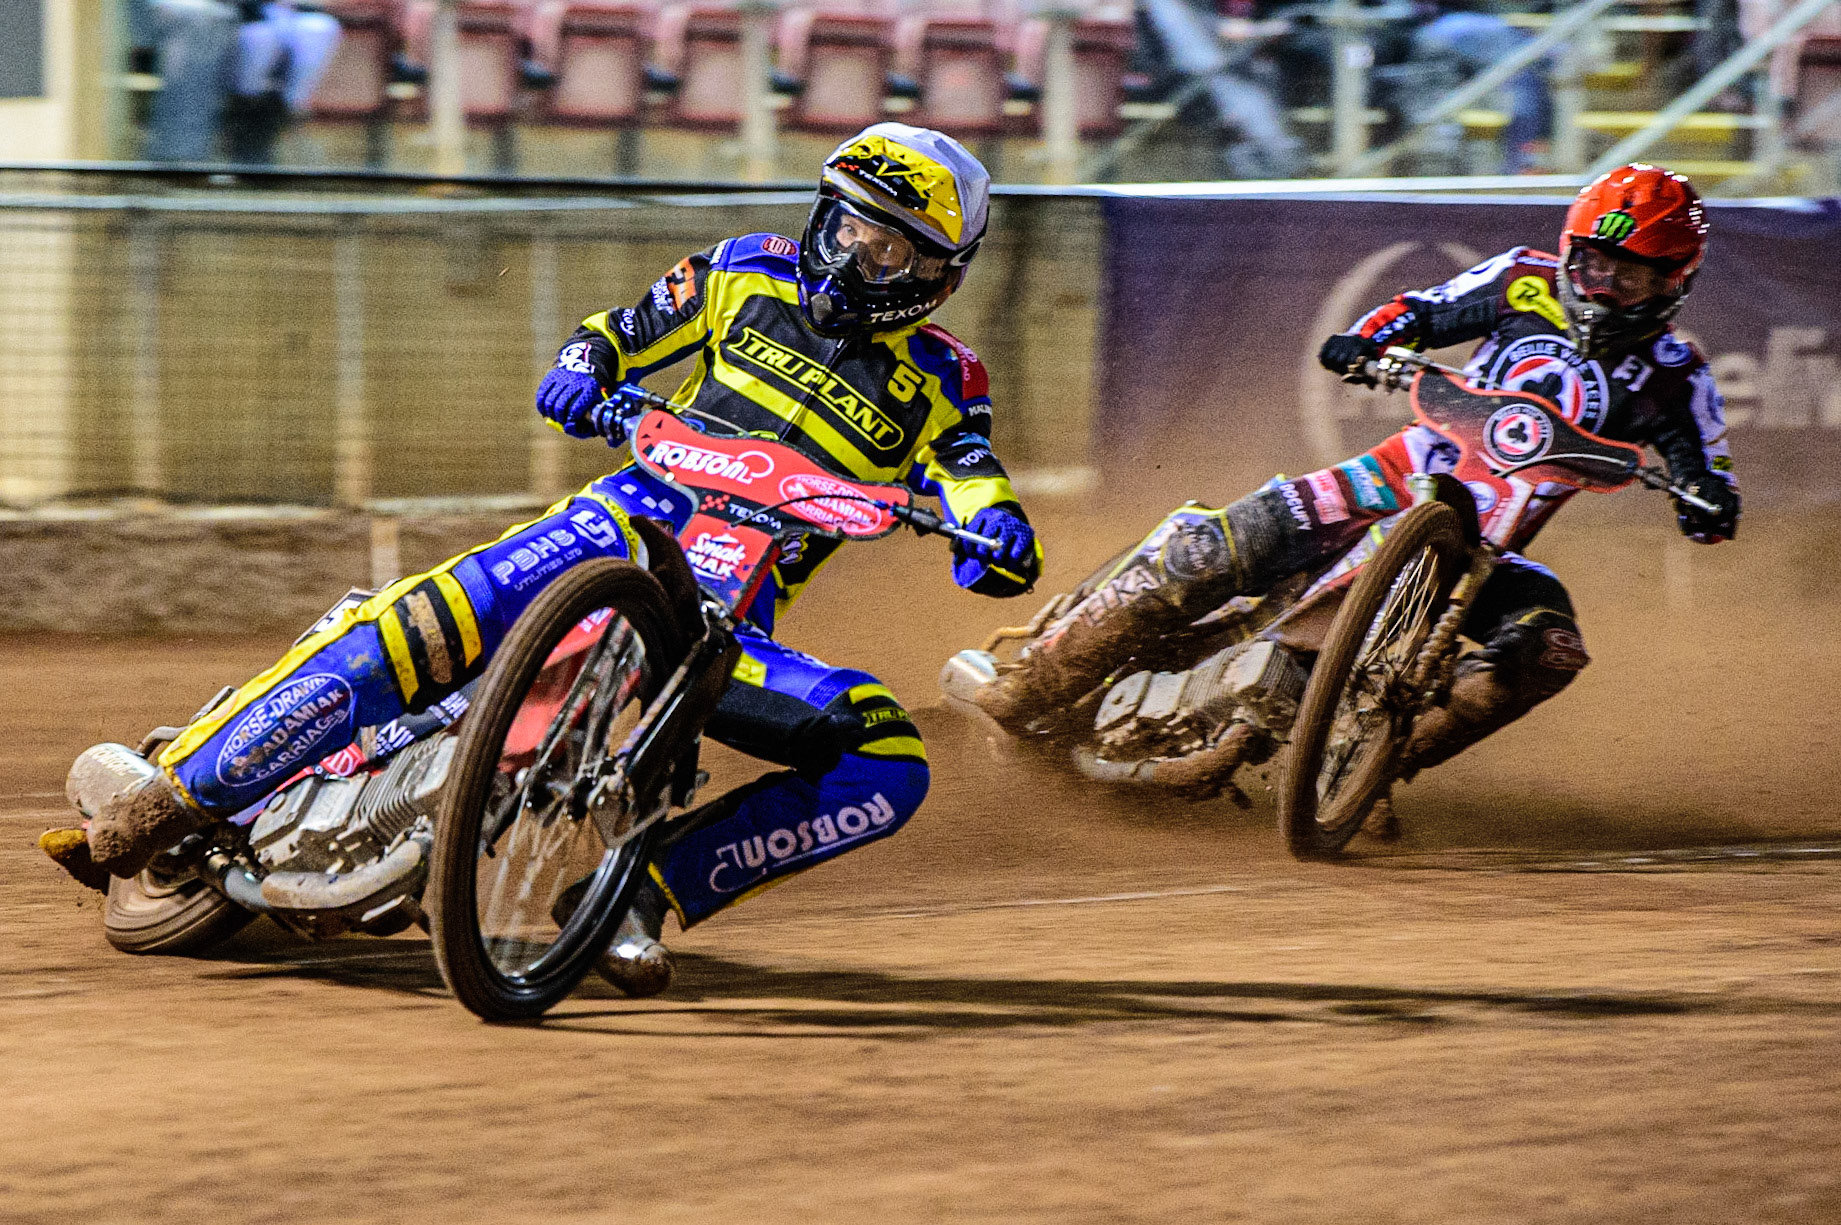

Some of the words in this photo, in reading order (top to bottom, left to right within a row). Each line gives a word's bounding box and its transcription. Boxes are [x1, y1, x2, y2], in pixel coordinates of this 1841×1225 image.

[858, 169, 898, 197] TEXOM
[870, 299, 937, 324] TEXOM
[745, 336, 804, 375] TRU
[798, 366, 894, 441] PLANT
[887, 363, 923, 402] 5
[514, 556, 564, 591] UTILITIES
[566, 547, 583, 562] LTD
[223, 677, 327, 759] HORSE-DRAWN
